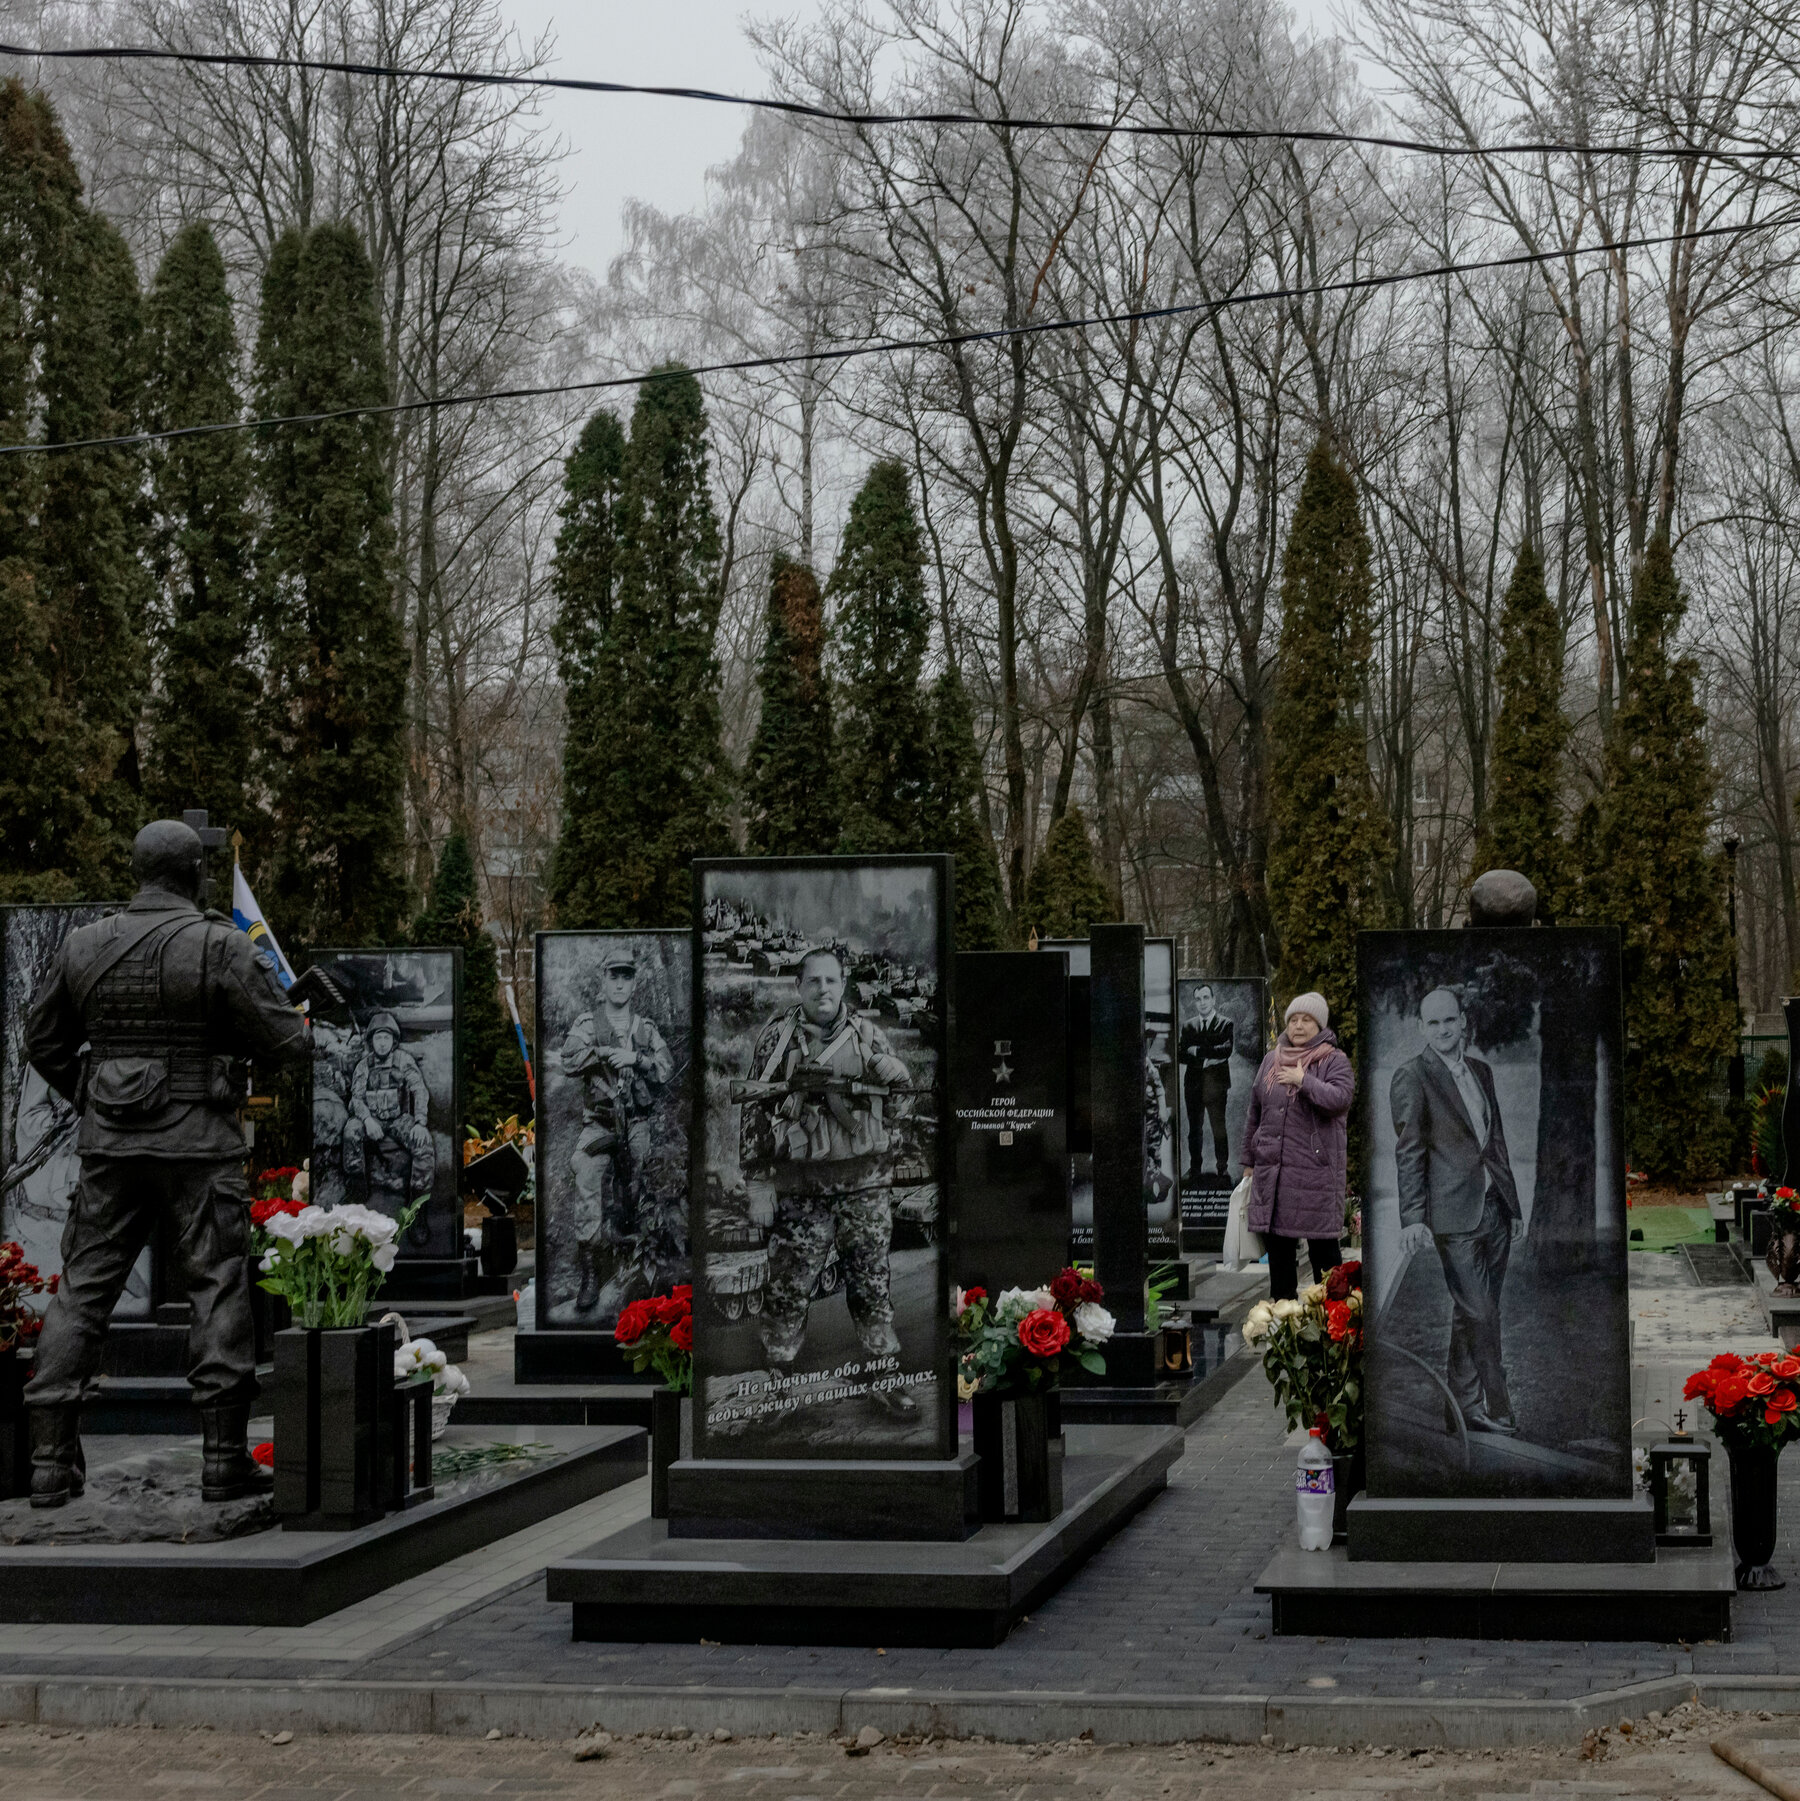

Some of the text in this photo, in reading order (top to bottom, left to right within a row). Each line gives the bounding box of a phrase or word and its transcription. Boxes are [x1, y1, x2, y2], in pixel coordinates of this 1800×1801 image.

[990, 1096, 1016, 1106] ГЕРОЙ
[1006, 1108, 1055, 1118] ФЕДЕРАЦИИ
[1148, 1235, 1177, 1244] сегда...
[737, 1356, 901, 1397] Не плачьте обо мне,
[707, 1370, 938, 1424] ведь я живу в ваших сердцах.
